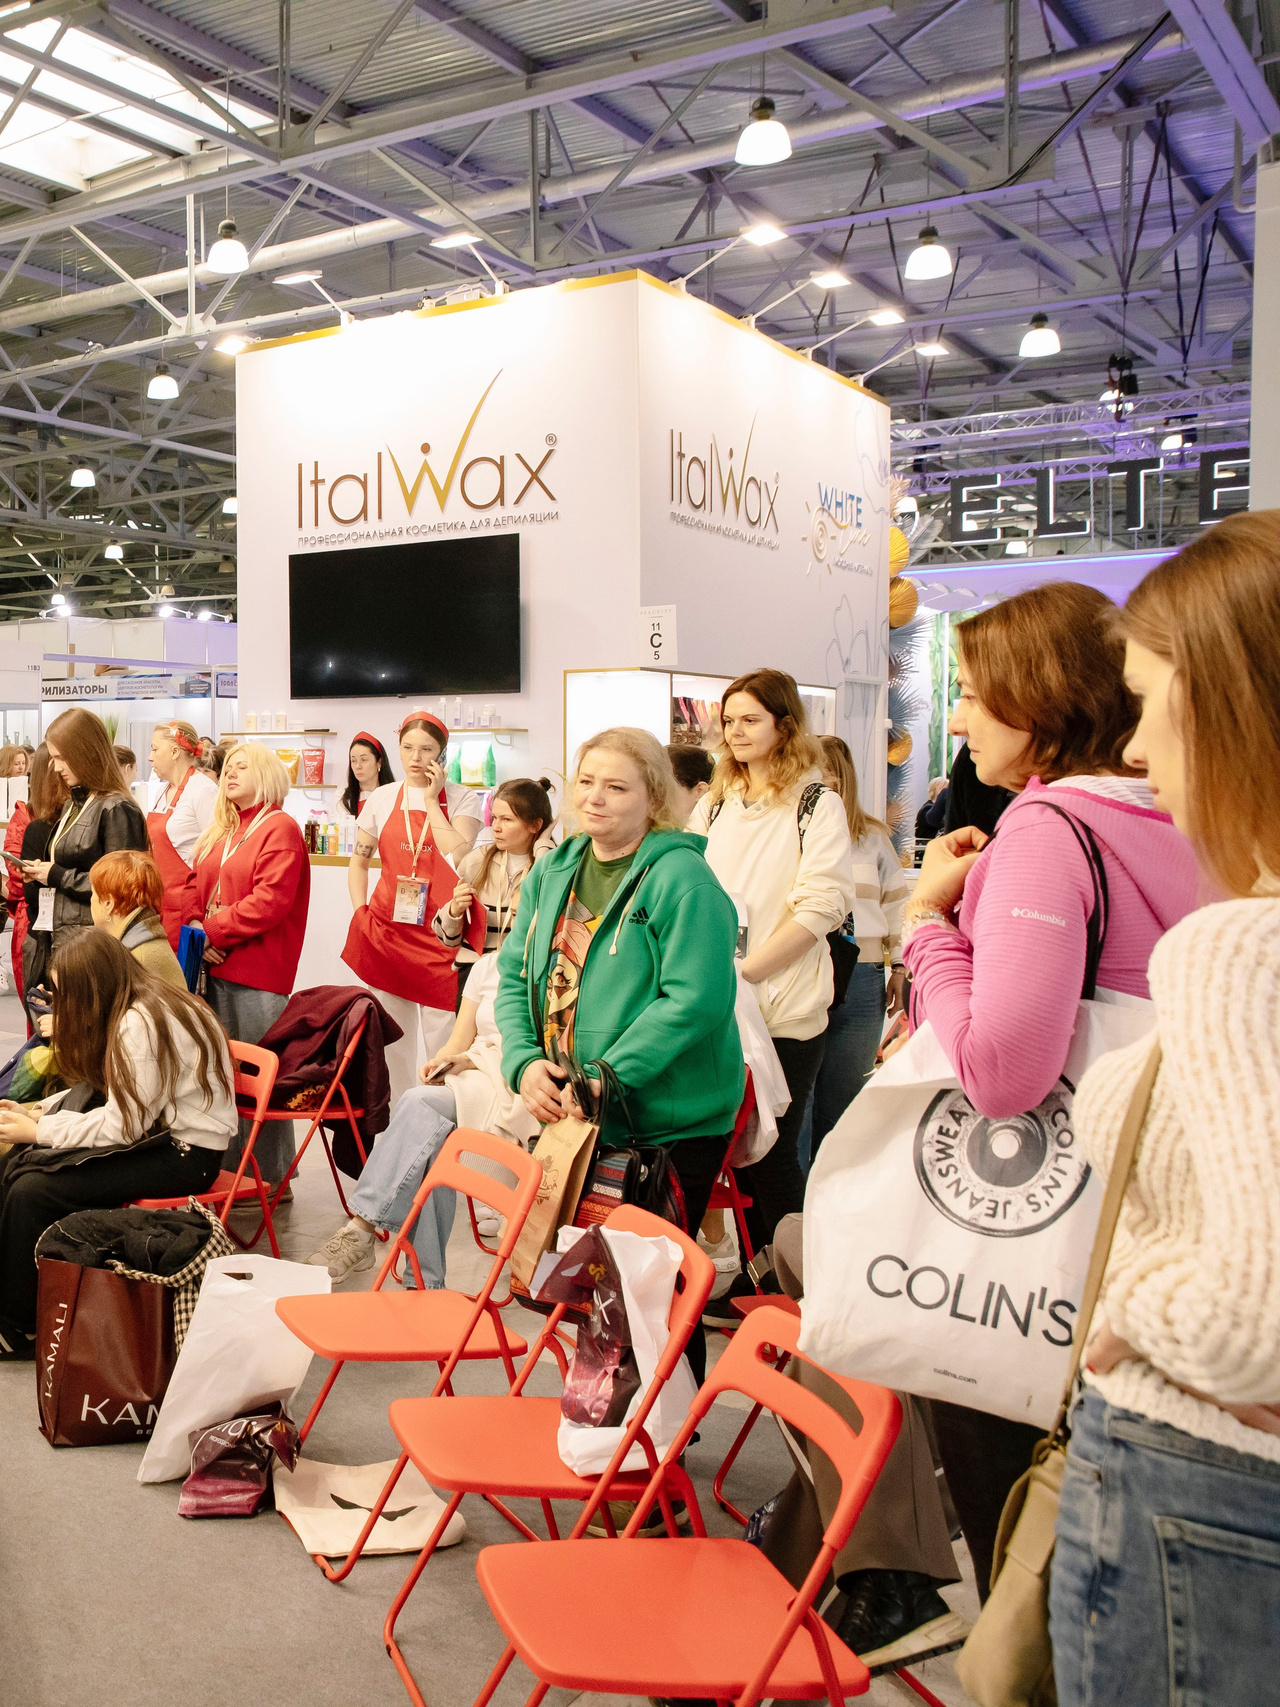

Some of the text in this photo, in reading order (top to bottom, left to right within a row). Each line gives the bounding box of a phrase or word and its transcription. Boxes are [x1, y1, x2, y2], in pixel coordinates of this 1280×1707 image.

[297, 368, 557, 529] ItalWax
[670, 402, 780, 534] ItalWax
[297, 511, 559, 548] ПРОФЕССИОНАЛЬНАЯ КОСМЕТИКА ДЛЯ ДЕПИЛЯЦИИ
[818, 481, 863, 528] WHITE
[900, 449, 1251, 544] ELTE
[650, 622, 661, 631] 11
[653, 650, 660, 661] 5
[400, 841, 433, 853] Itaax
[1020, 908, 1066, 927] Columbia
[935, 1095, 1011, 1219] JEANSWEA
[1025, 1107, 1075, 1213] COLIN'S
[866, 1254, 1077, 1347] COLIN'S
[44, 1302, 68, 1398] KAMALI
[933, 1366, 977, 1385] colins.com
